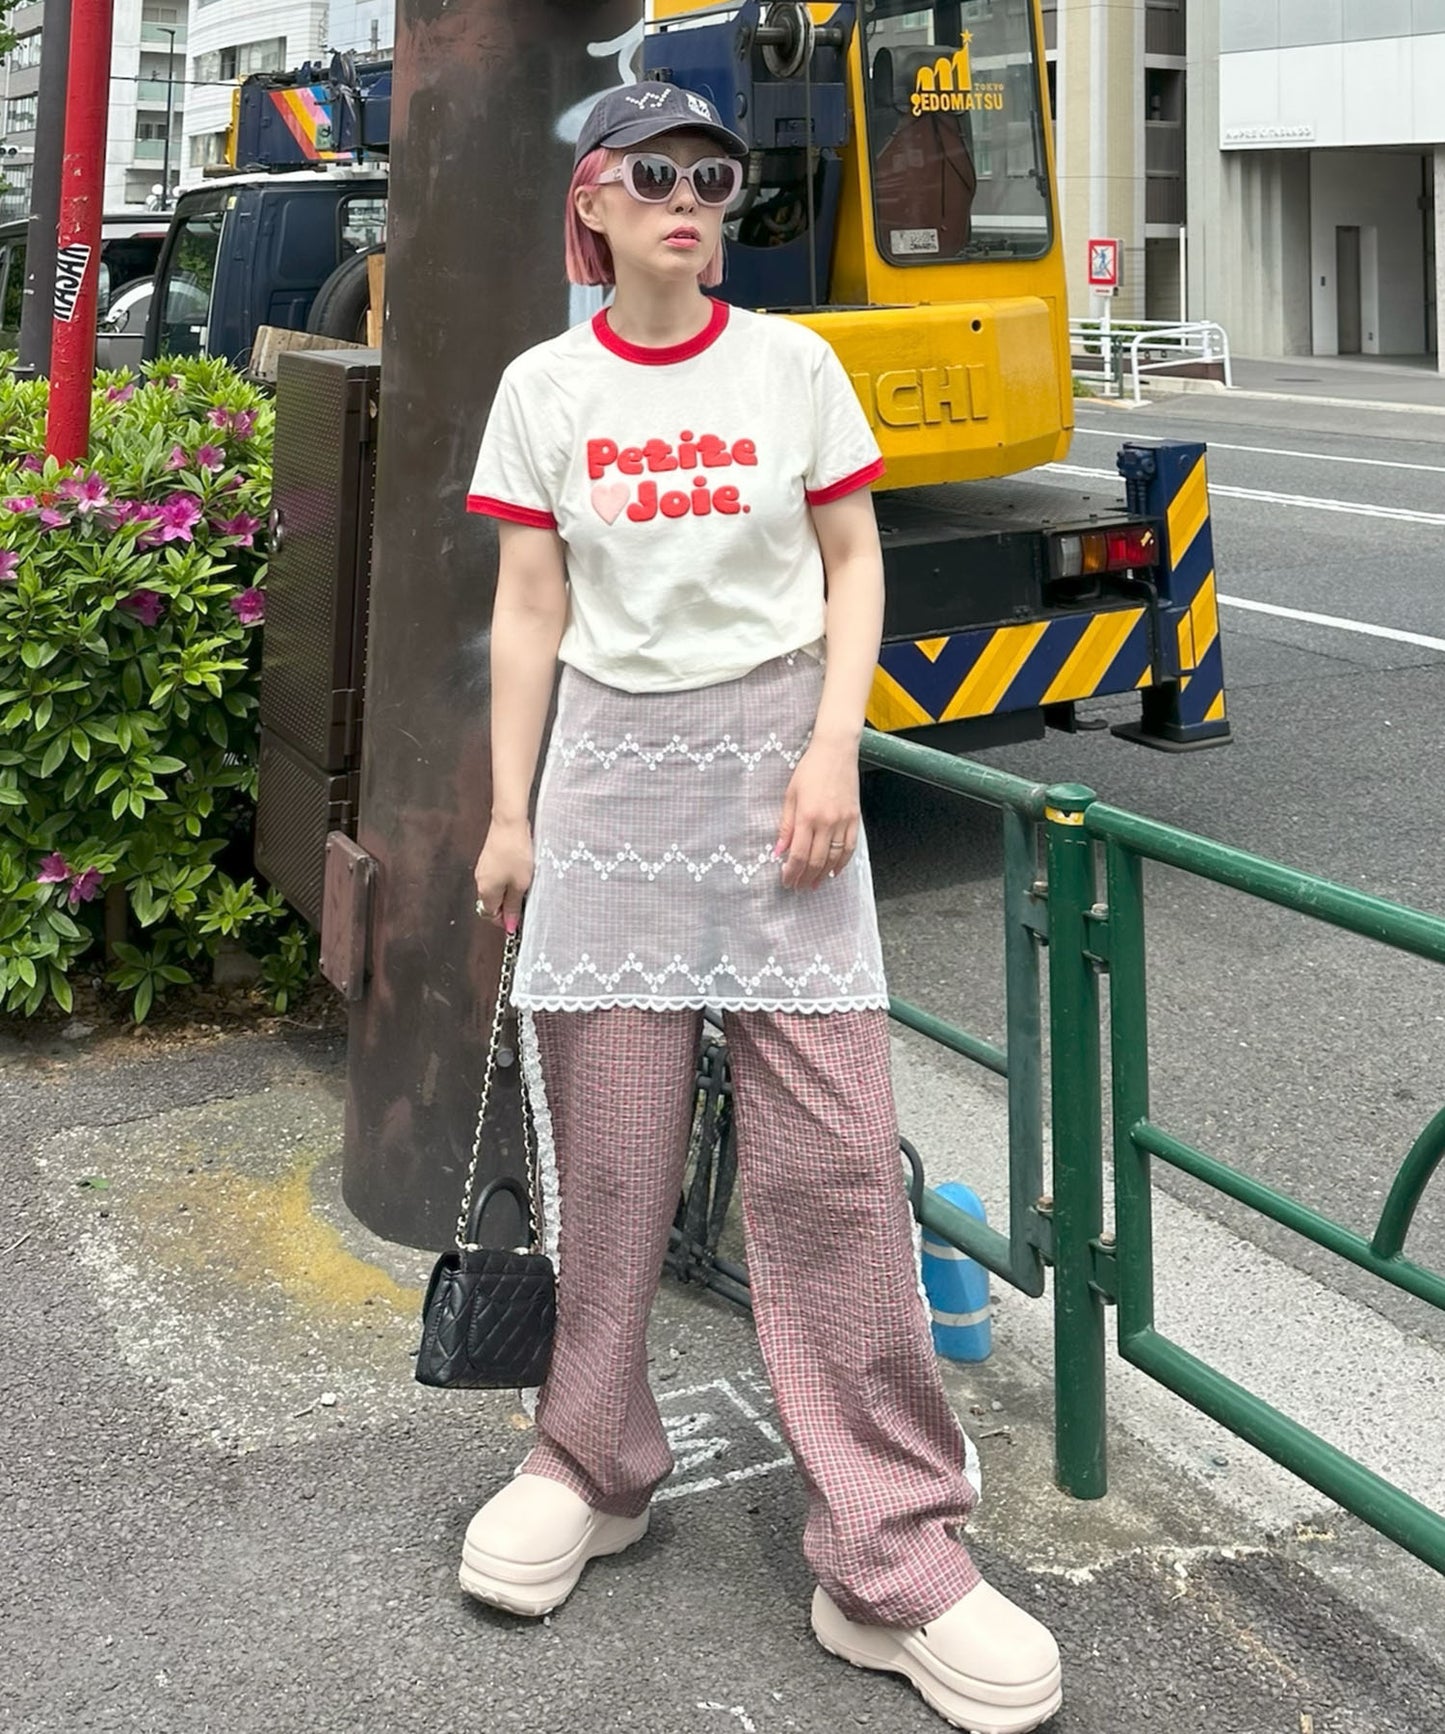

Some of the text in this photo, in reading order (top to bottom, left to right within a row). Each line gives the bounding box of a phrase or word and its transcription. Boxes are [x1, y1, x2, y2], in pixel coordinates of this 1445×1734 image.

[920, 92, 1004, 112] EDOMATSU
[973, 82, 1005, 92] TOKYO
[586, 429, 758, 481] Petite
[626, 475, 751, 523] Joie.
